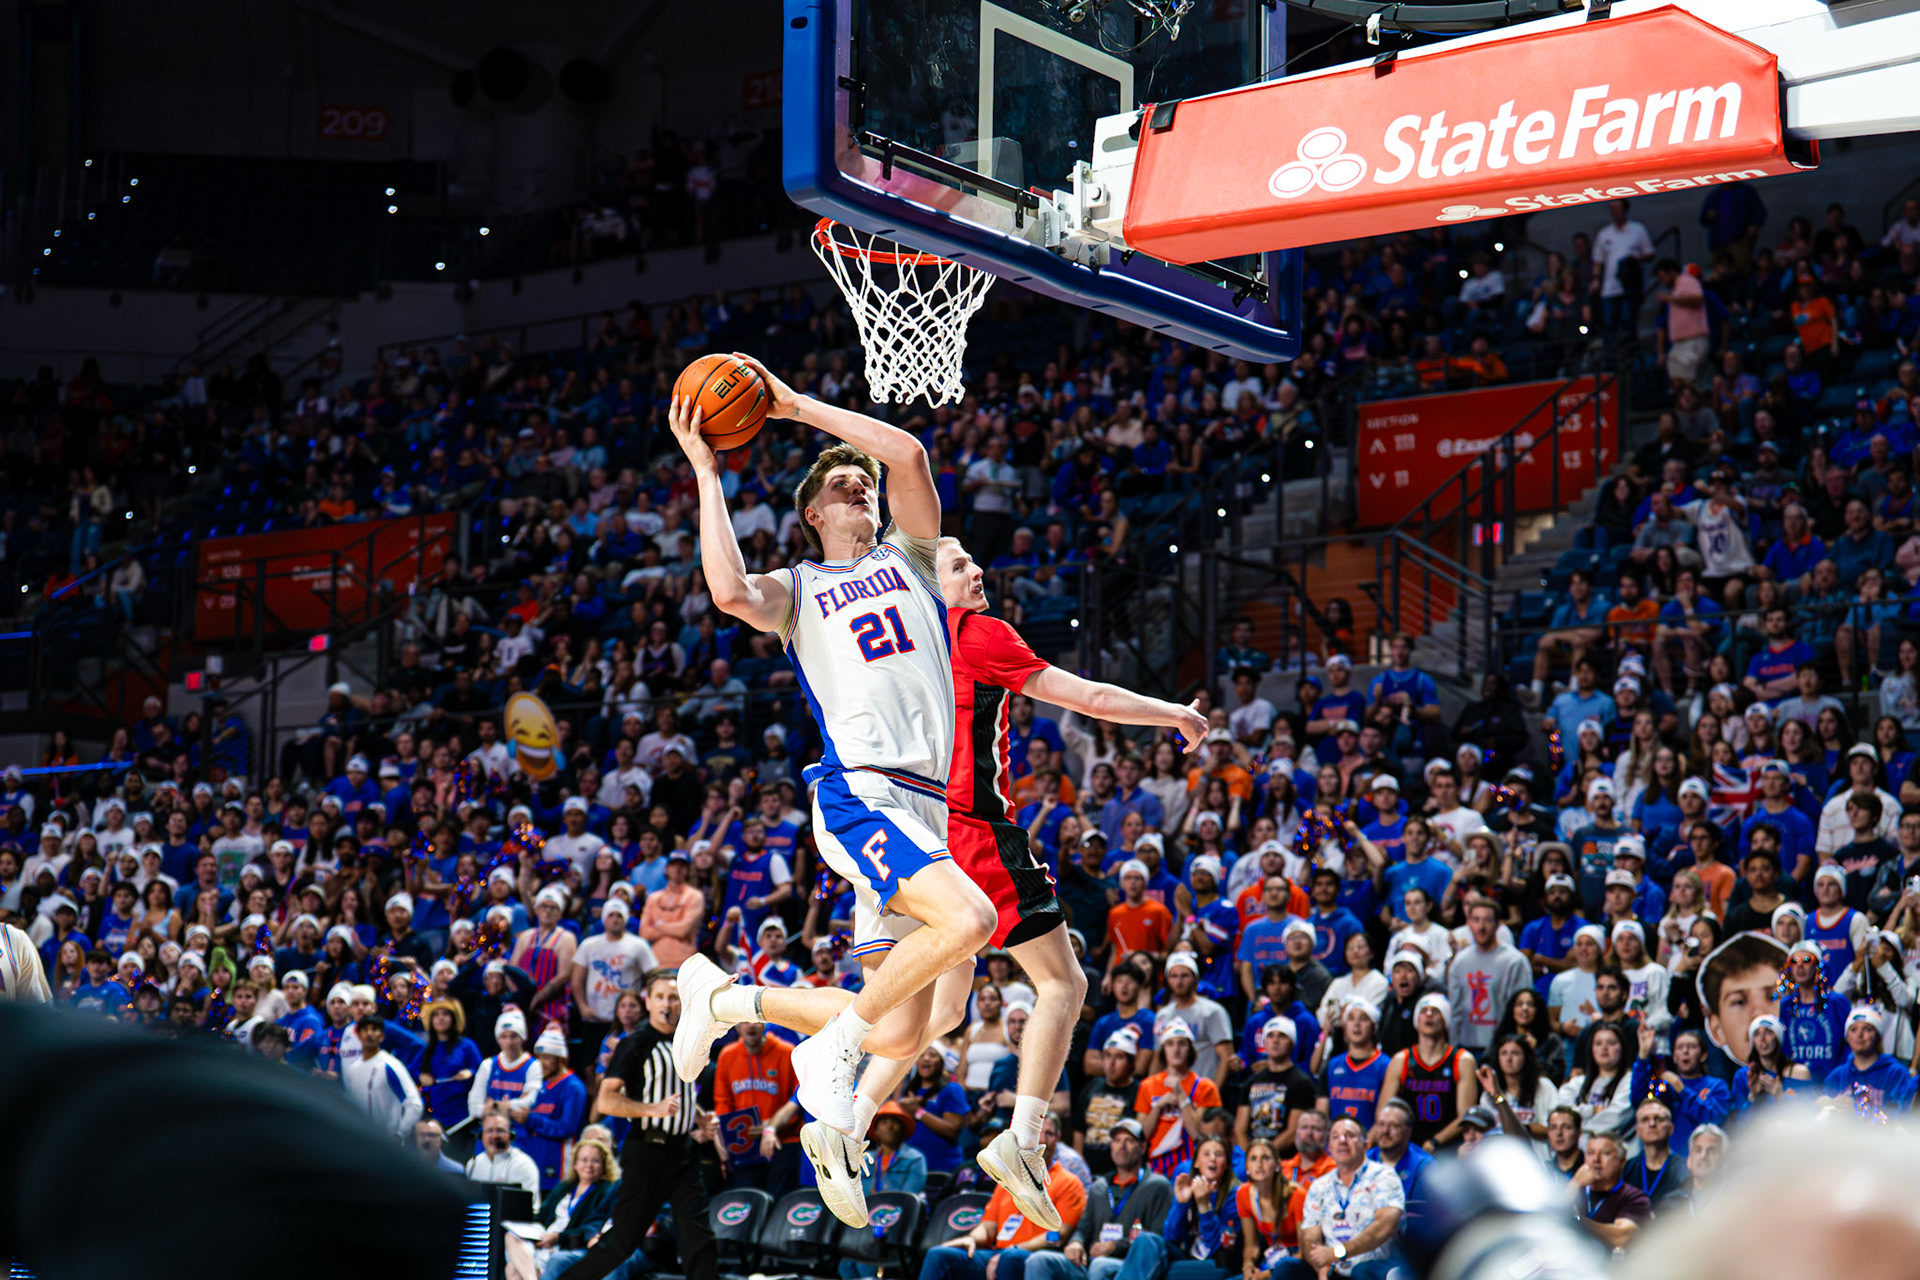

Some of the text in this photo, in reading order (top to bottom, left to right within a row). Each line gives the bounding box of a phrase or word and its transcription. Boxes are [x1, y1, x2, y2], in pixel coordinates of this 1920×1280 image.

[322, 109, 387, 136] 209
[712, 364, 752, 400] ELITE
[815, 566, 911, 619] FLORIDA
[849, 605, 916, 663] 21
[861, 827, 891, 882] F
[1417, 1094, 1442, 1122] 10
[727, 1114, 755, 1154] 3
